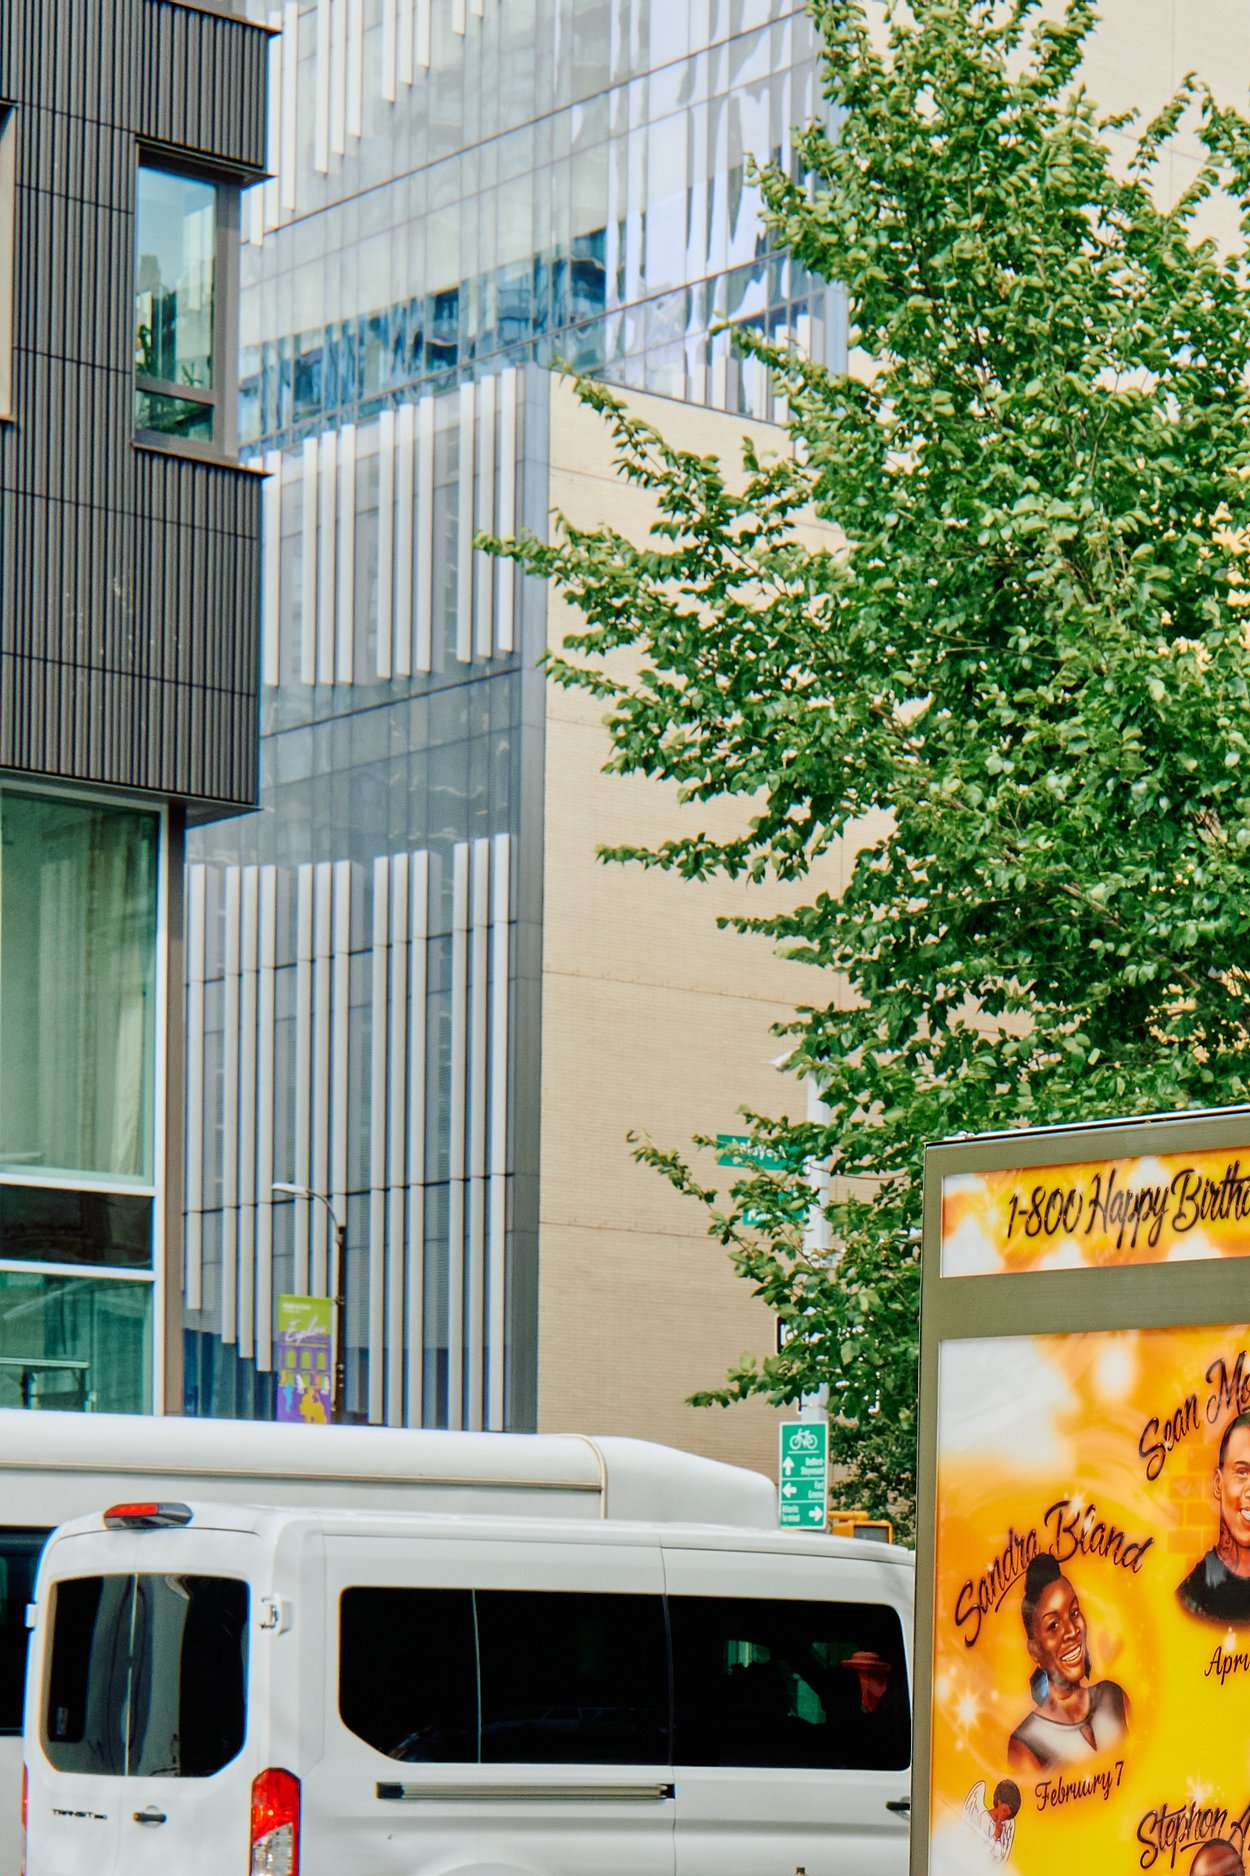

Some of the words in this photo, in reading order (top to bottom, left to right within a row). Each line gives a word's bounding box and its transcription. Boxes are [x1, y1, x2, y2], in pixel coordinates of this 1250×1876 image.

[1007, 1186, 1084, 1240] 1-800
[1080, 1168, 1170, 1250] Happy
[1138, 1392, 1200, 1482] Sean
[955, 1524, 1041, 1648] Sandra
[1043, 1499, 1155, 1573] Bland
[1034, 1770, 1114, 1812] February
[1114, 1761, 1126, 1788] 7
[1136, 1800, 1227, 1870] Stephon
